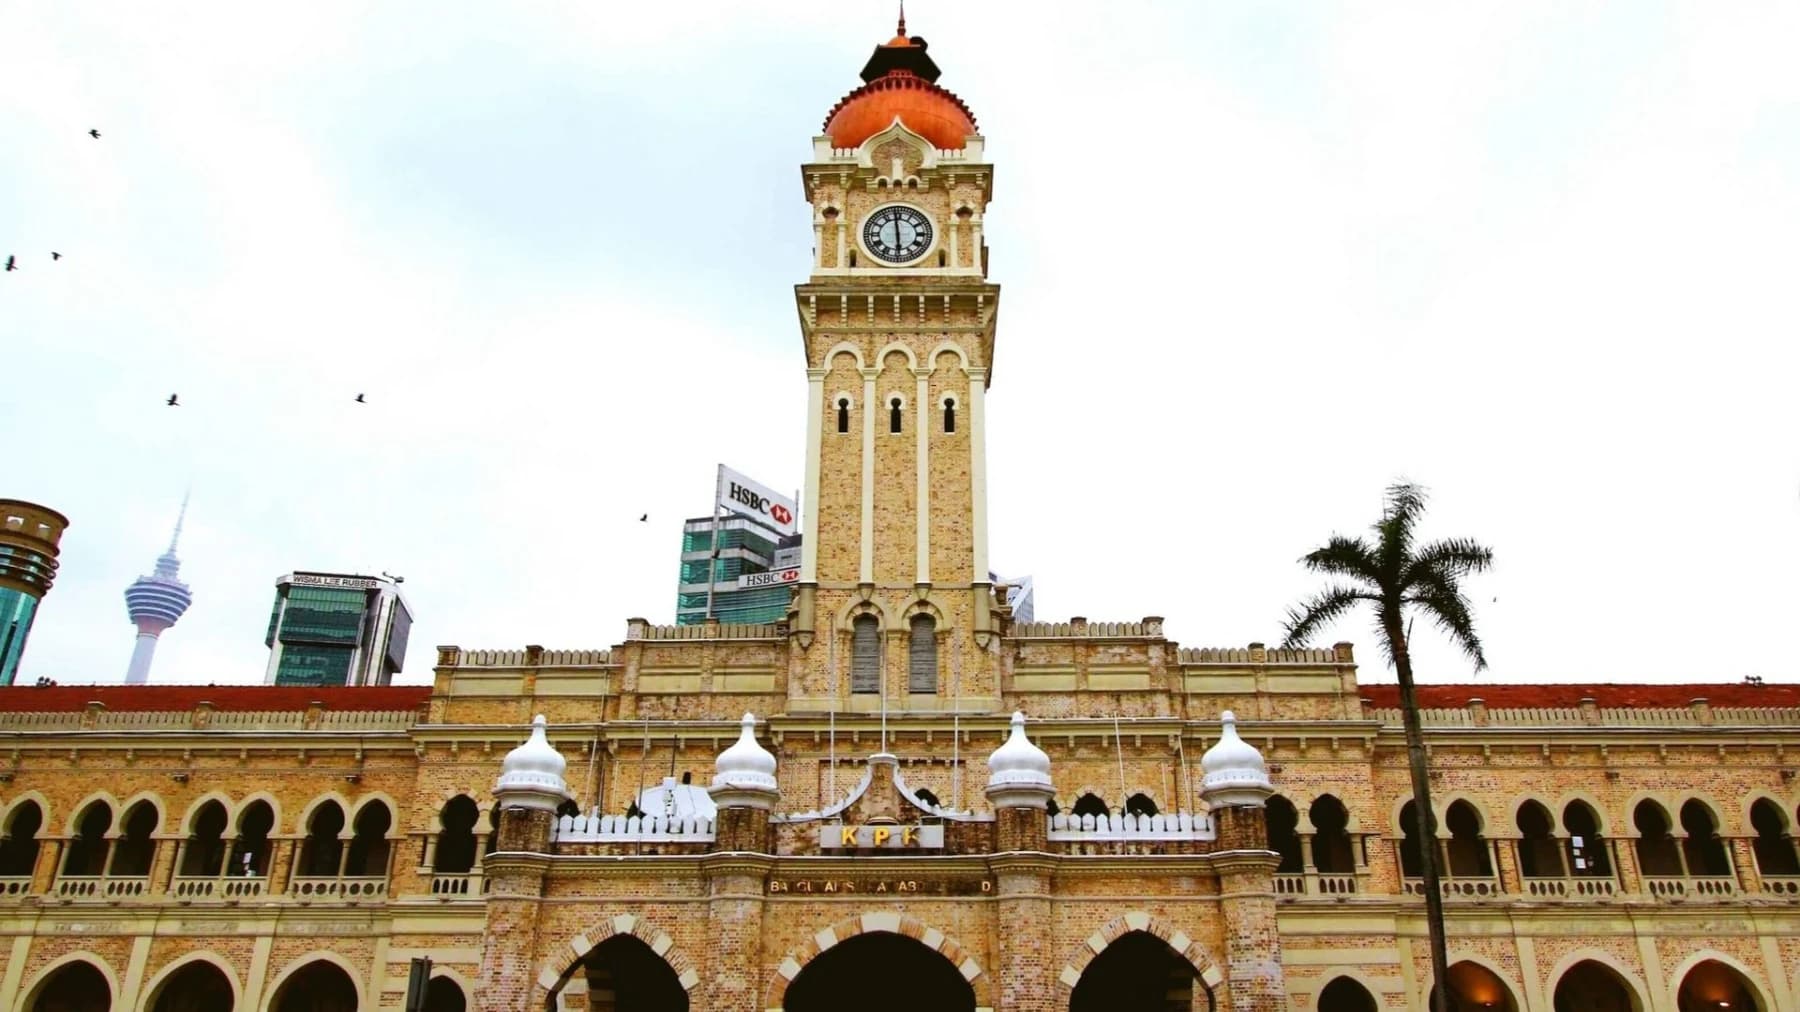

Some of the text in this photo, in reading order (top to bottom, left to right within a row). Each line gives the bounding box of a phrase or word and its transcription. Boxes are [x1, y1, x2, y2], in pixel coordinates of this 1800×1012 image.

[729, 482, 770, 515] HSBC
[294, 575, 321, 585] WISMA
[342, 578, 377, 588] RUBBER
[746, 572, 780, 586] HSBC
